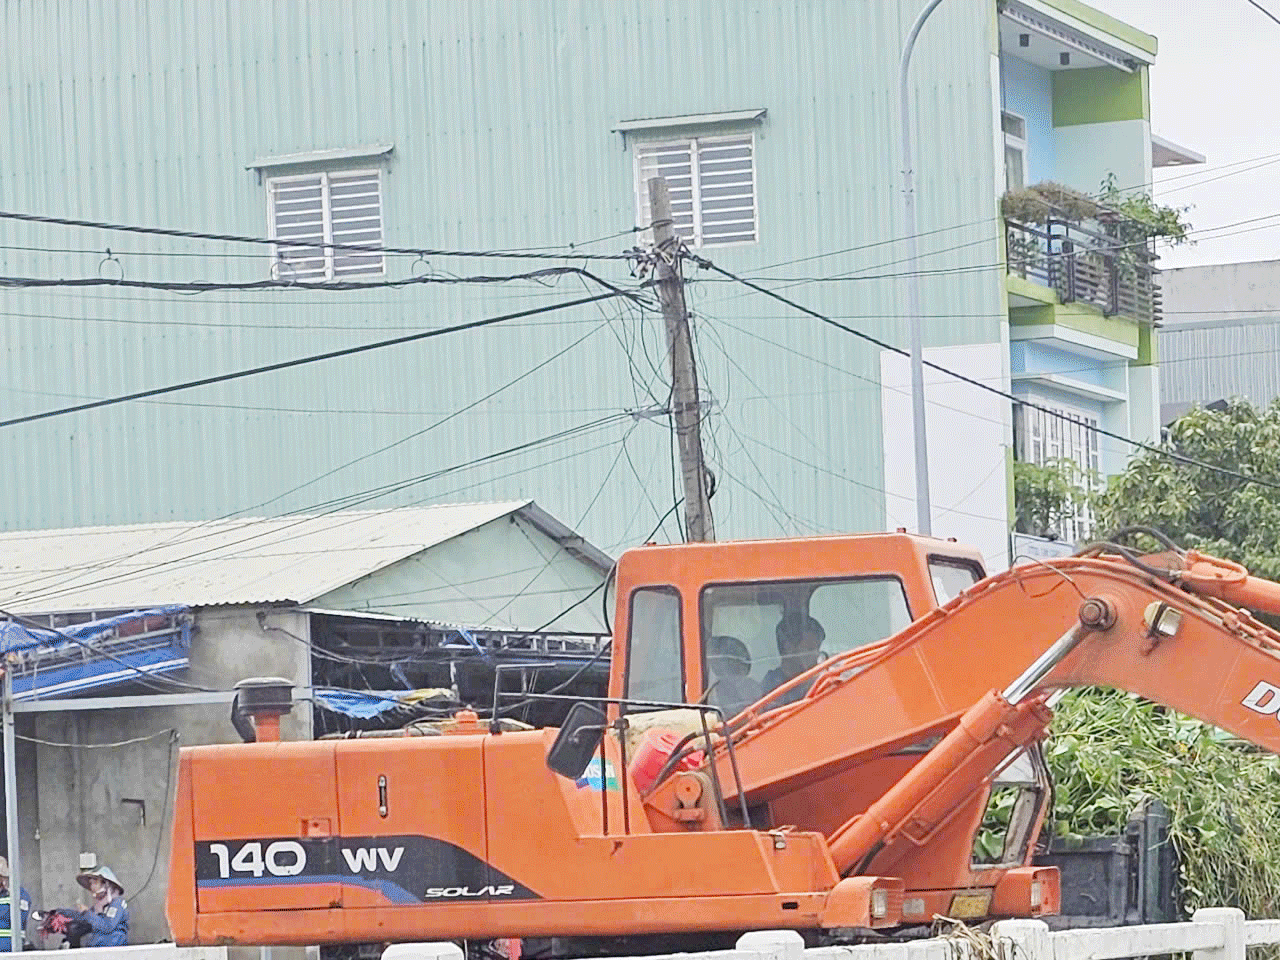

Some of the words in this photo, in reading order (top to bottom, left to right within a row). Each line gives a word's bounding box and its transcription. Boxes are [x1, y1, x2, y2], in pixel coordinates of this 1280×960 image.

[210, 841, 307, 879] 140
[341, 847, 405, 874] WV
[425, 884, 515, 898] SOLAR
